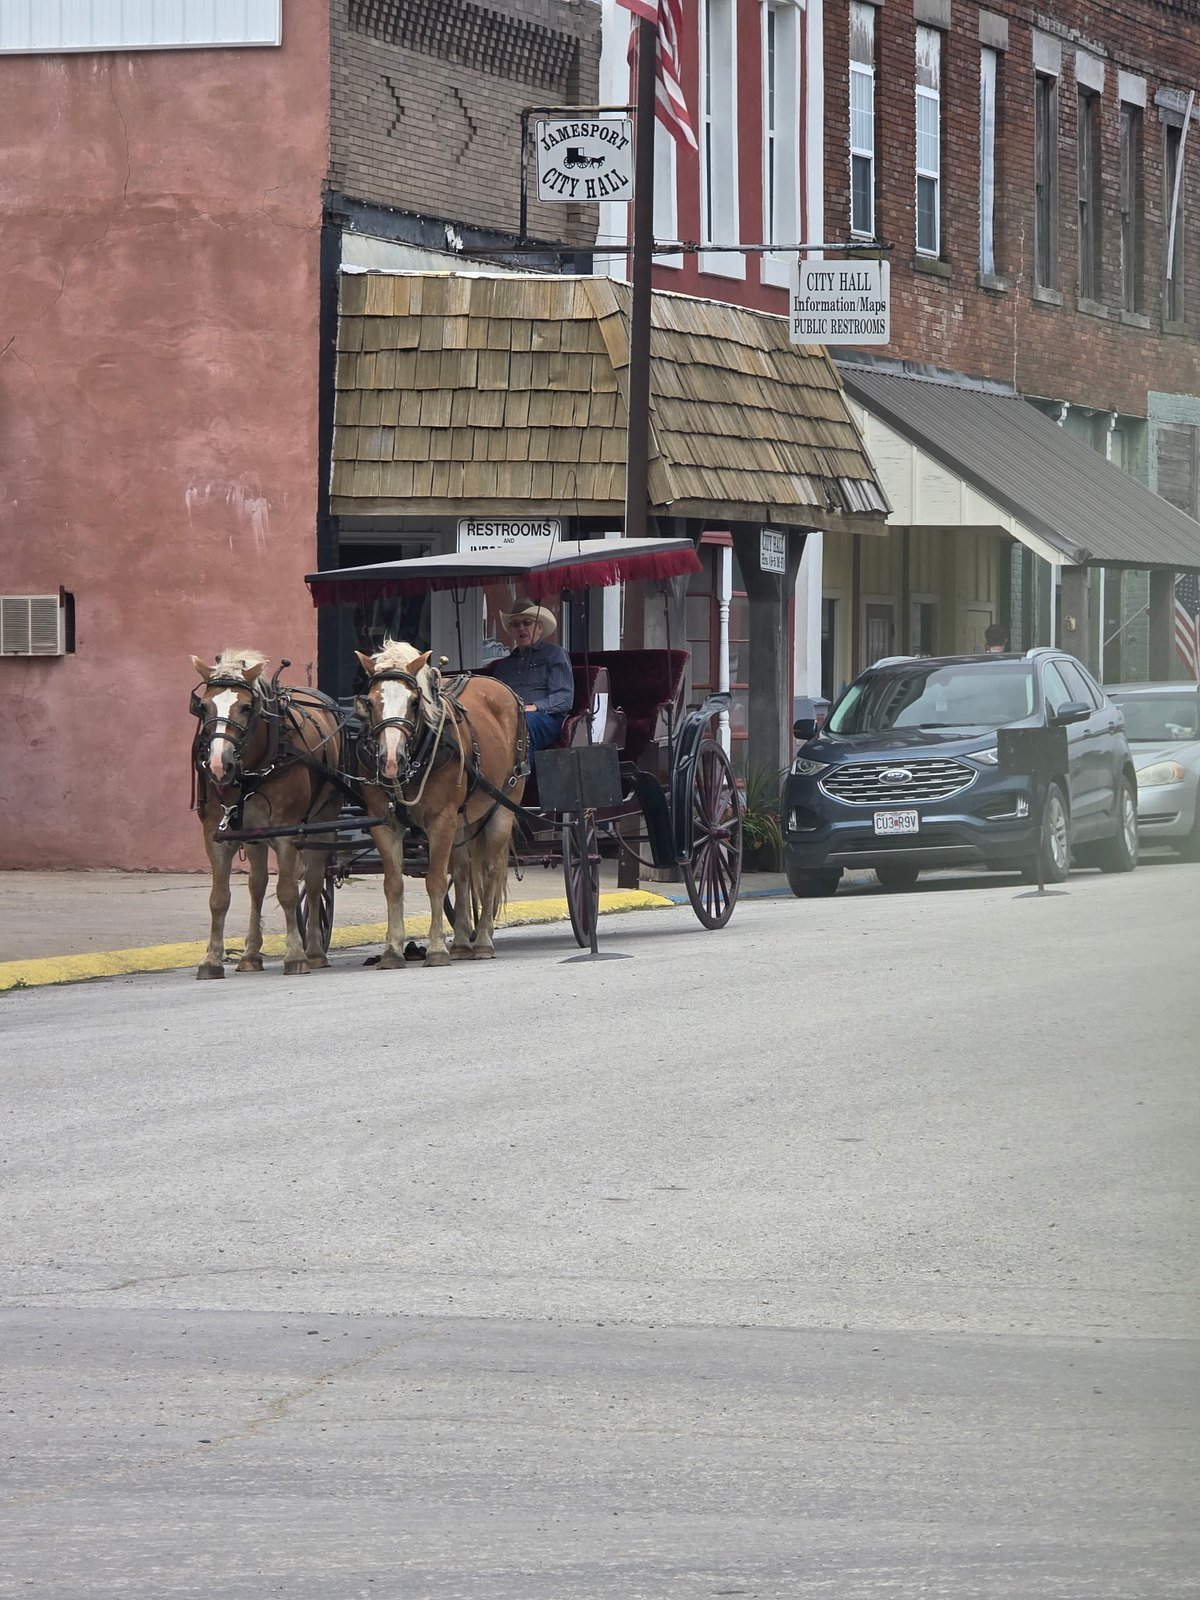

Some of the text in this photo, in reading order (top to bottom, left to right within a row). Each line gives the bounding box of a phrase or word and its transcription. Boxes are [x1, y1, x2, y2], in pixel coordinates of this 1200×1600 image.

[540, 123, 630, 151] JAMESPORT
[542, 167, 630, 199] CITY HALL
[806, 272, 872, 292] CITY HALL
[793, 296, 887, 316] Information/Maps
[793, 318, 886, 335] PUBLIC RESTROOMS
[467, 522, 552, 537] RESTROOMS
